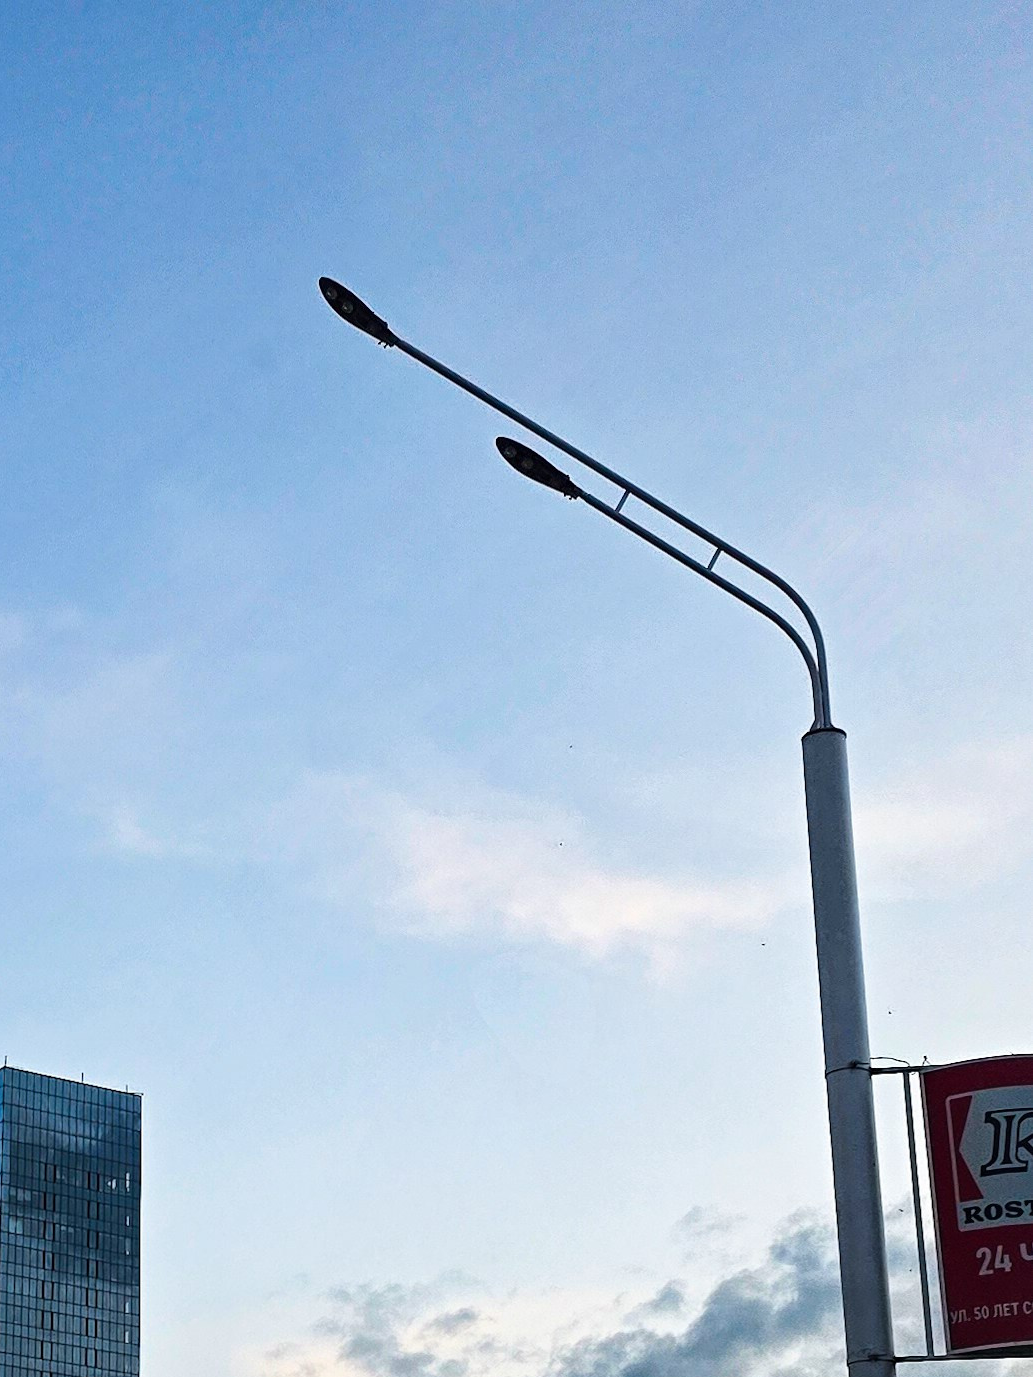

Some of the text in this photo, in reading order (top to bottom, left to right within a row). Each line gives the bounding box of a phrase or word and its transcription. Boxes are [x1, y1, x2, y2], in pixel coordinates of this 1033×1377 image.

[976, 1245, 1013, 1276] 24
[950, 1301, 1033, 1325] УЛ. 50 ЛЕТ С
